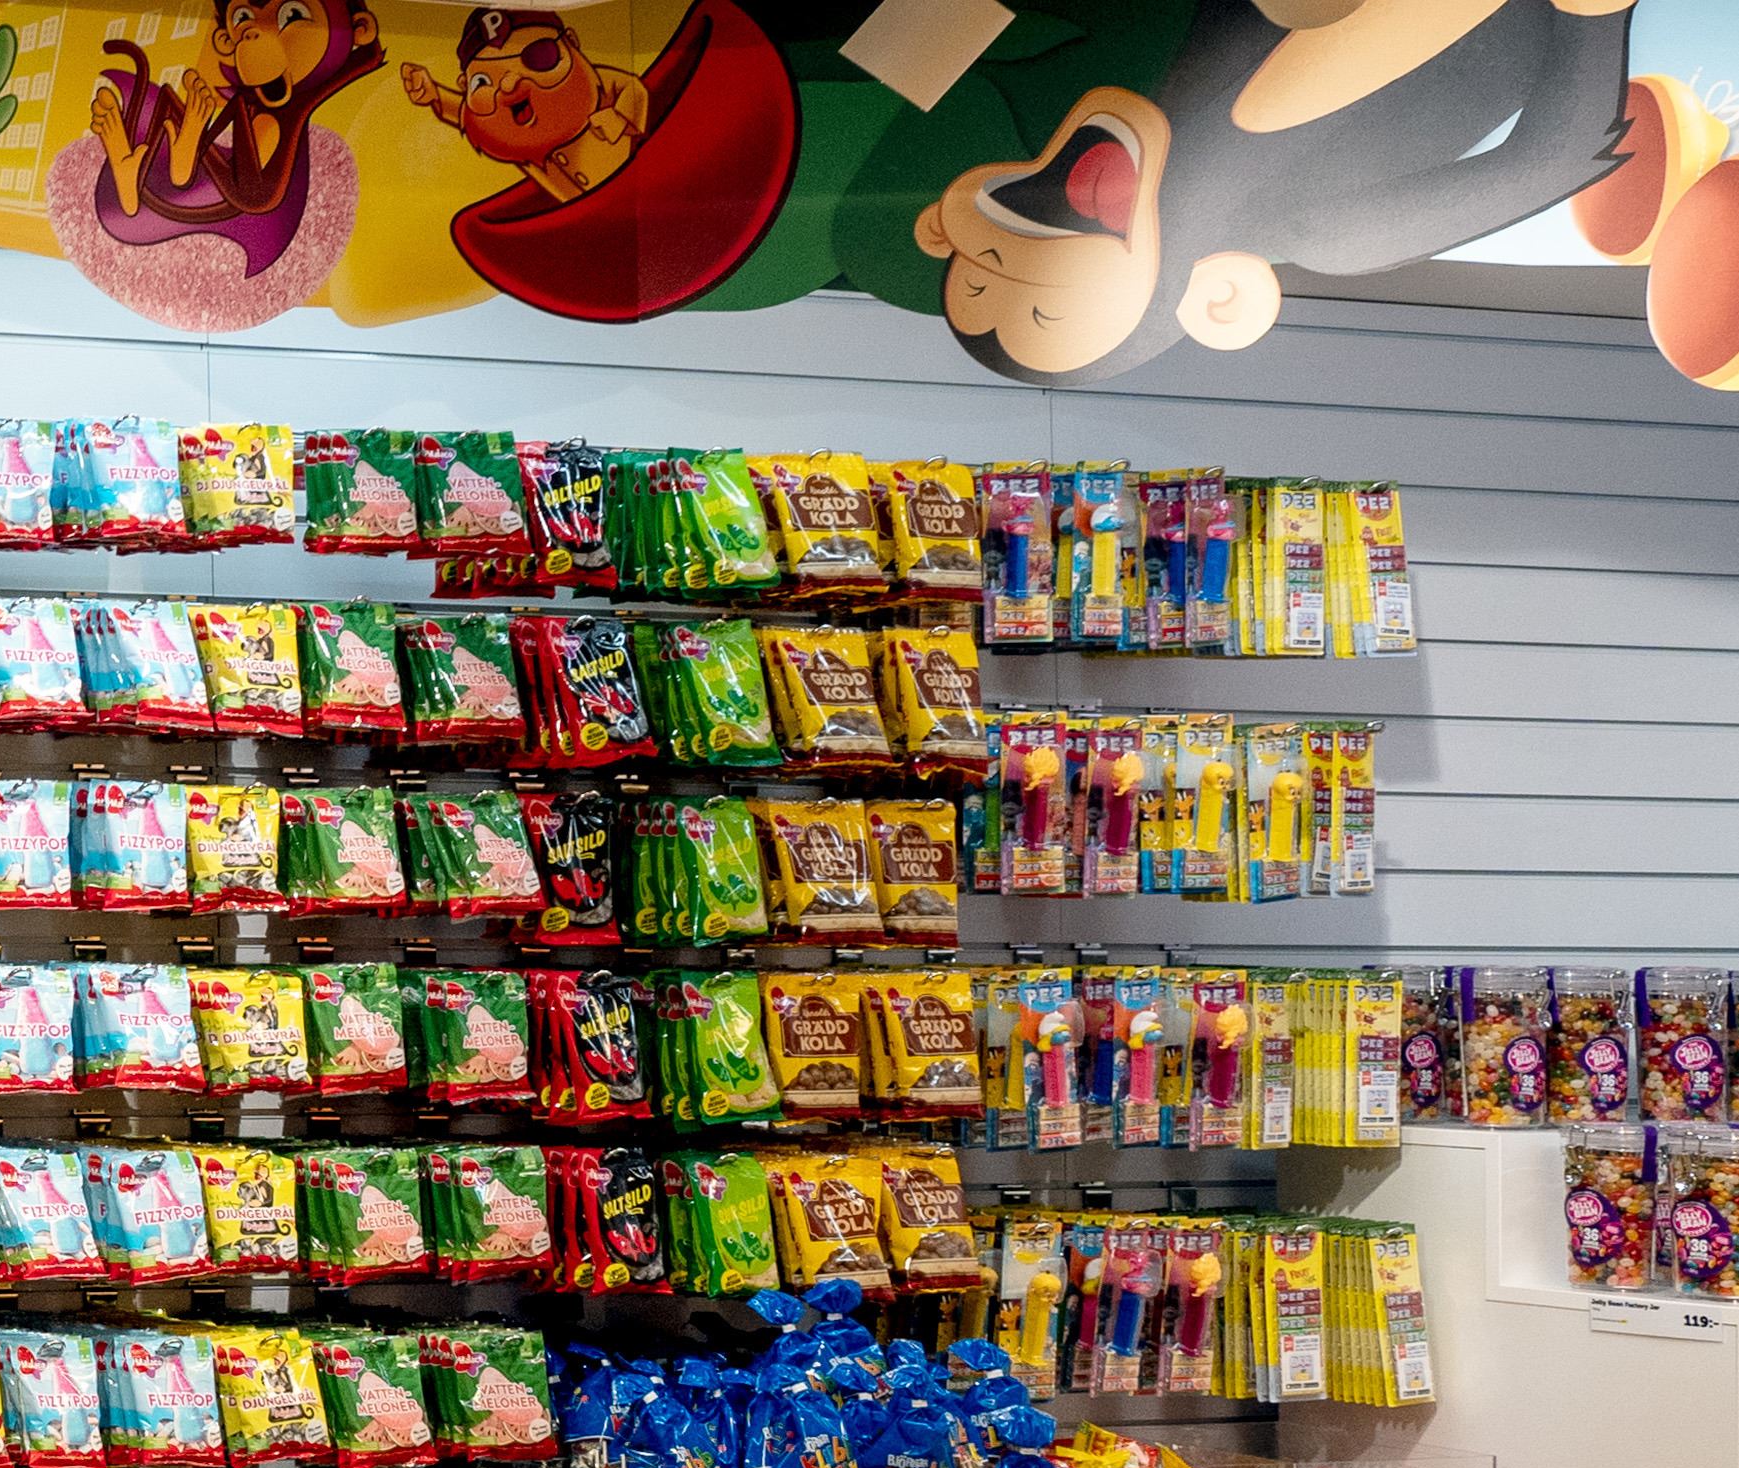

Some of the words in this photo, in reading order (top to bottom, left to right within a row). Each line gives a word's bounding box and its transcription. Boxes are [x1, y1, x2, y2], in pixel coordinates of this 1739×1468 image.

[799, 493, 861, 512] GRÄDD
[1280, 492, 1317, 510] PEZ
[1356, 494, 1390, 510] PEZ
[809, 509, 857, 526] KOLA
[574, 829, 606, 852] SILD
[889, 846, 941, 864] GRÄDD
[902, 862, 939, 880] KOLA
[1024, 986, 1067, 1002] PEZ
[1200, 987, 1242, 1003] PEZ
[1353, 985, 1393, 1000] PEZ
[792, 1018, 849, 1035] GRÄDD
[464, 1034, 519, 1049] MELONER
[800, 1036, 846, 1051] KOLA
[1522, 1075, 1534, 1087] 36
[1602, 1075, 1615, 1087] 36
[134, 1204, 203, 1226] FIZZYPOP
[1583, 1228, 1599, 1240] 36
[1273, 1238, 1310, 1253] PEZ
[1691, 1239, 1708, 1251] 36
[1625, 1302, 1648, 1310] Factory
[1684, 1315, 1719, 1328] 119:-
